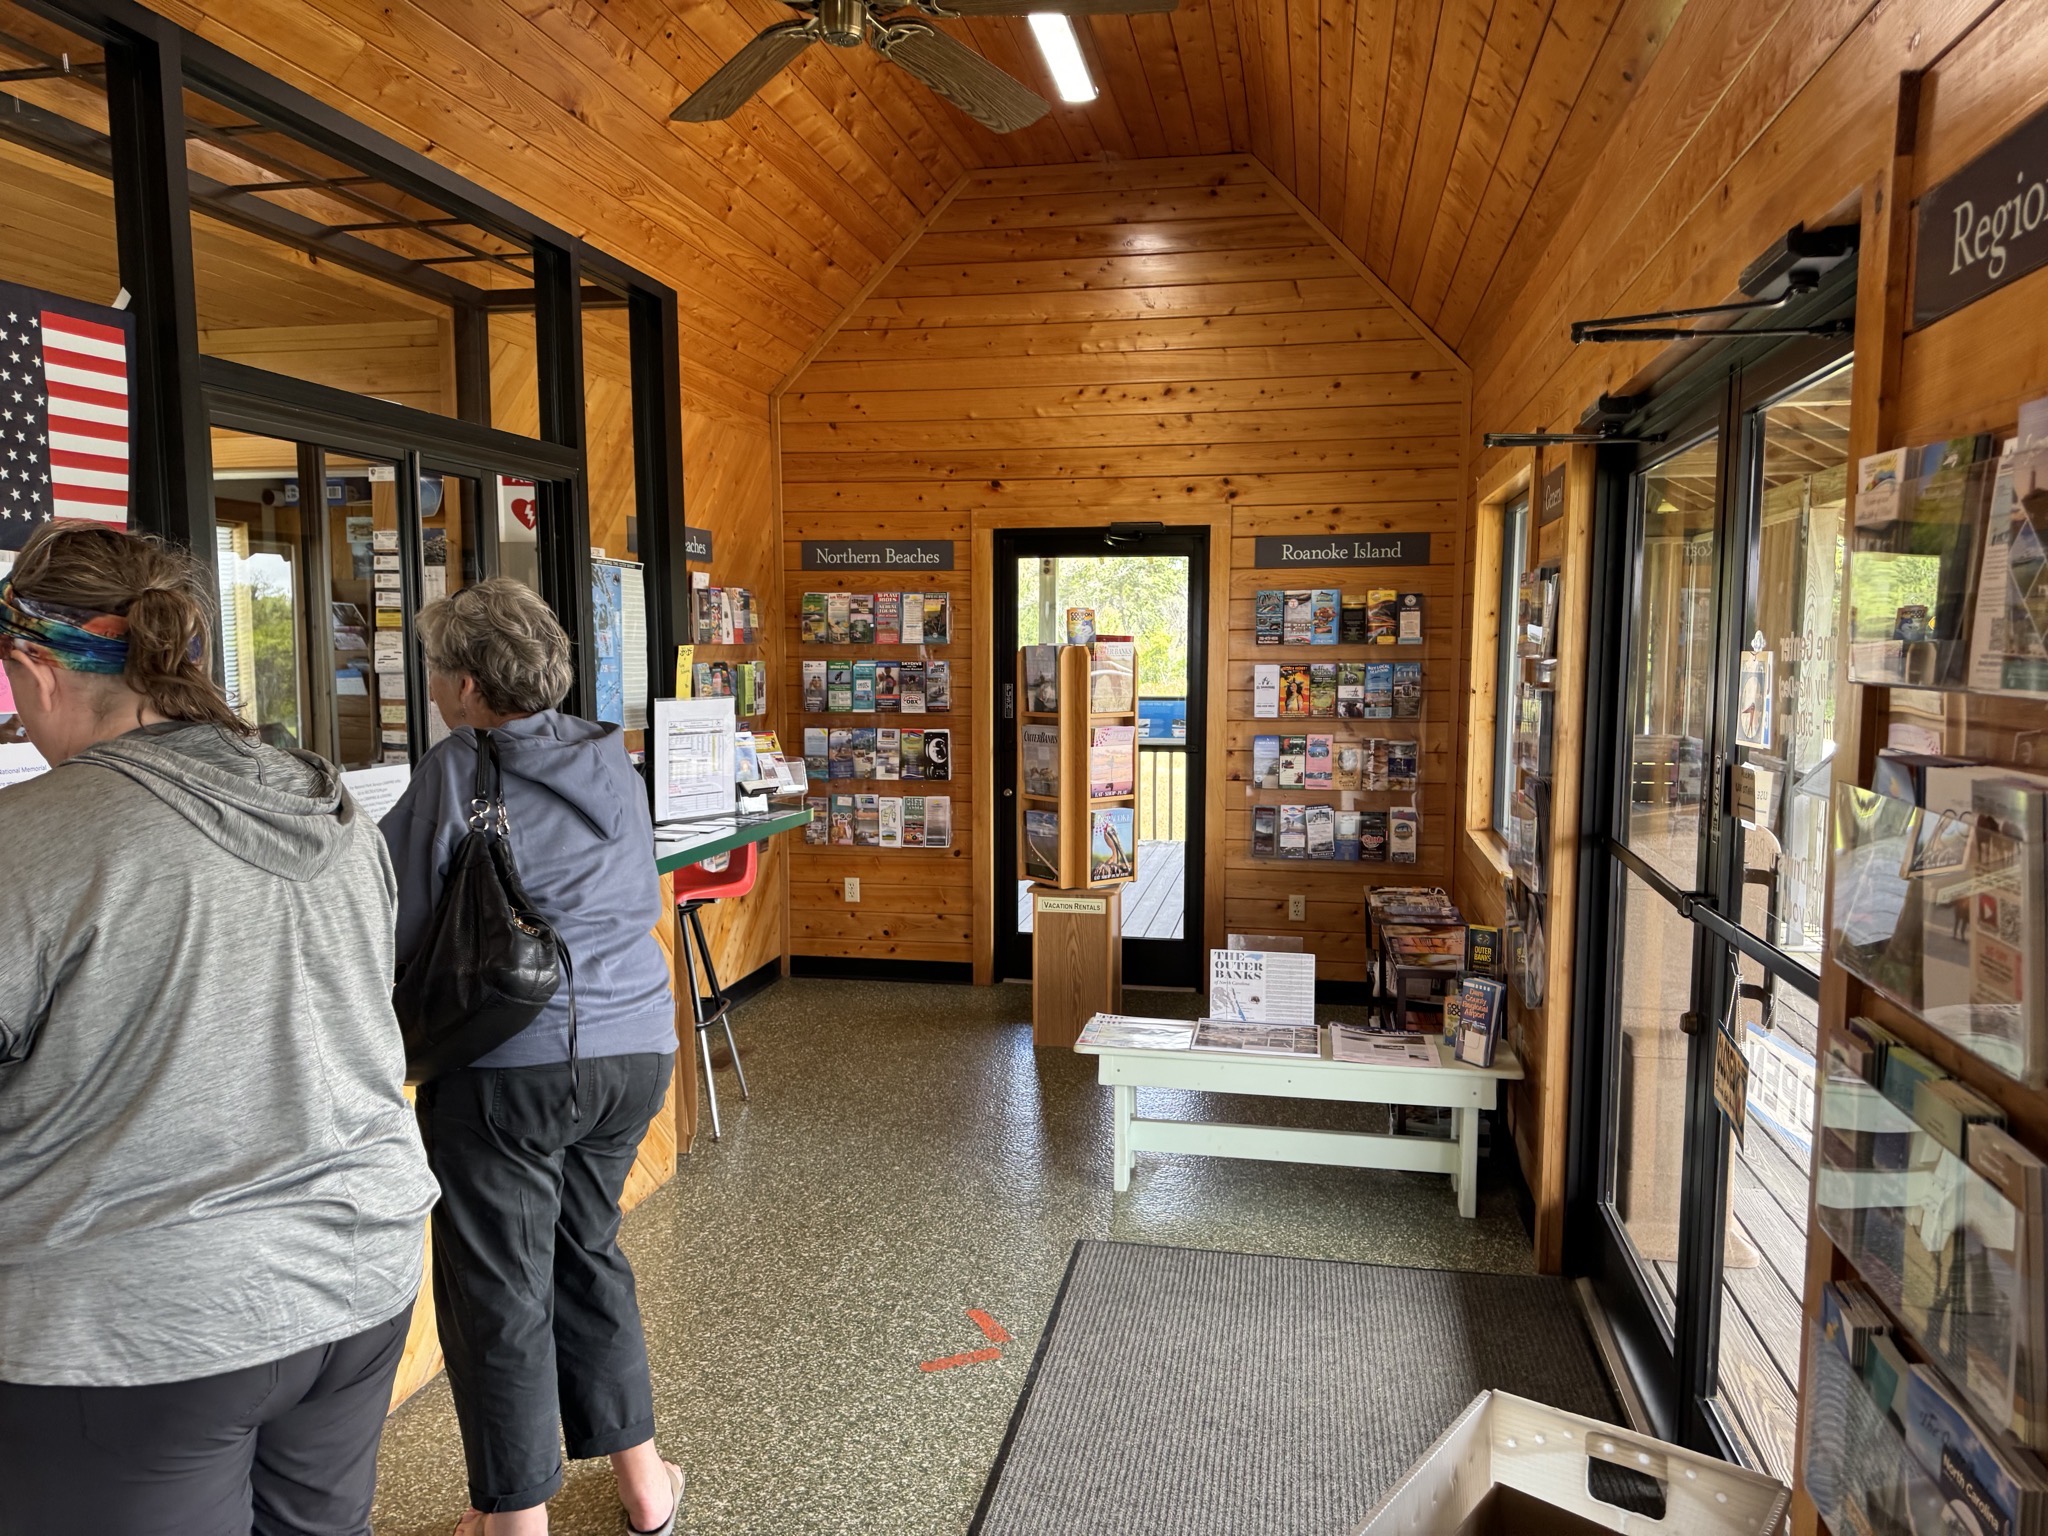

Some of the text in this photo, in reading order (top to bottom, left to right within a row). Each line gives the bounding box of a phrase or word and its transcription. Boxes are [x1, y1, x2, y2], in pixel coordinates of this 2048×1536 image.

[1949, 170, 2048, 280] Regio
[1545, 475, 1564, 511] General
[685, 536, 706, 555] aches
[1281, 541, 1402, 561] Roanoke Island
[816, 548, 940, 564] Northern Beaches
[0, 767, 20, 775] ational
[1043, 901, 1101, 911] VACATION RENTALS
[1474, 945, 1492, 955] OUTER
[1214, 951, 1245, 961] THE
[1473, 953, 1492, 963] BANKS
[1215, 960, 1263, 971] OUTER
[1215, 970, 1262, 980] BANKS
[1469, 988, 1484, 996] Dare
[1465, 994, 1487, 1006] County
[1462, 1001, 1489, 1013] Regional
[1464, 1009, 1486, 1020] Airport
[1943, 1453, 1999, 1533] North Carolina
